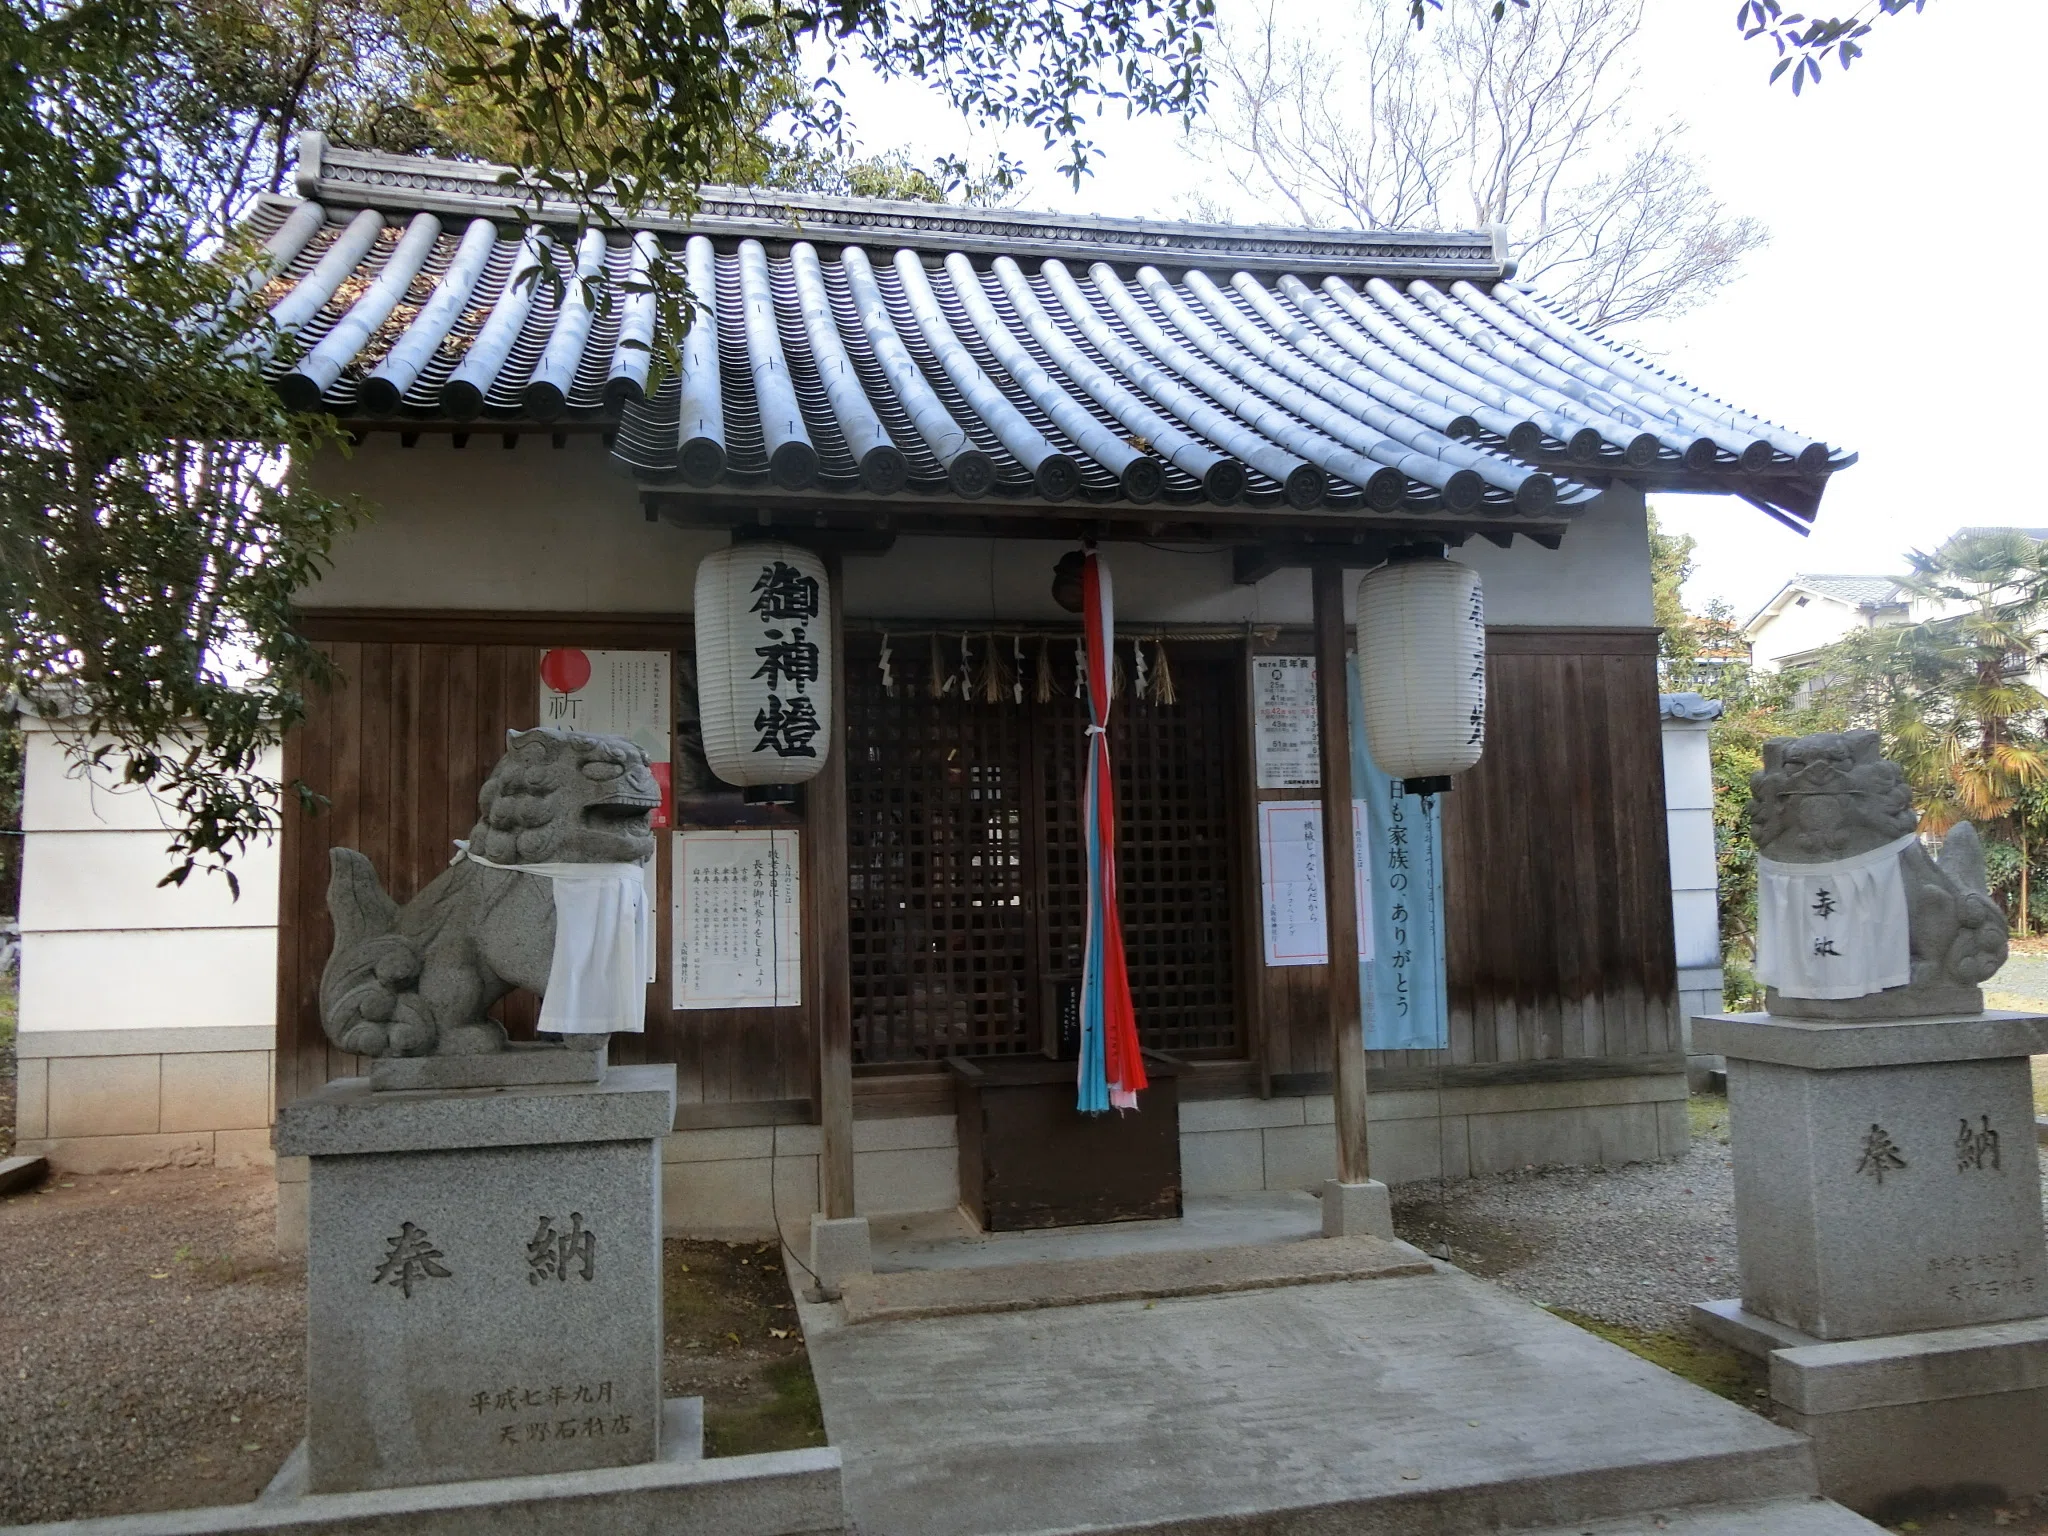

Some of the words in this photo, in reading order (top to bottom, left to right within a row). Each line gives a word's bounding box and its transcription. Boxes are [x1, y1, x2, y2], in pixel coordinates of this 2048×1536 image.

[749, 561, 821, 757] 御神燈
[1279, 658, 1309, 668] 厄年表
[1303, 820, 1318, 923] 機械じゃないんだから
[753, 859, 765, 987] 長寿の御礼参りをしましょう
[371, 1210, 597, 1299] 奉納
[469, 1380, 614, 1416] 平成七年九月
